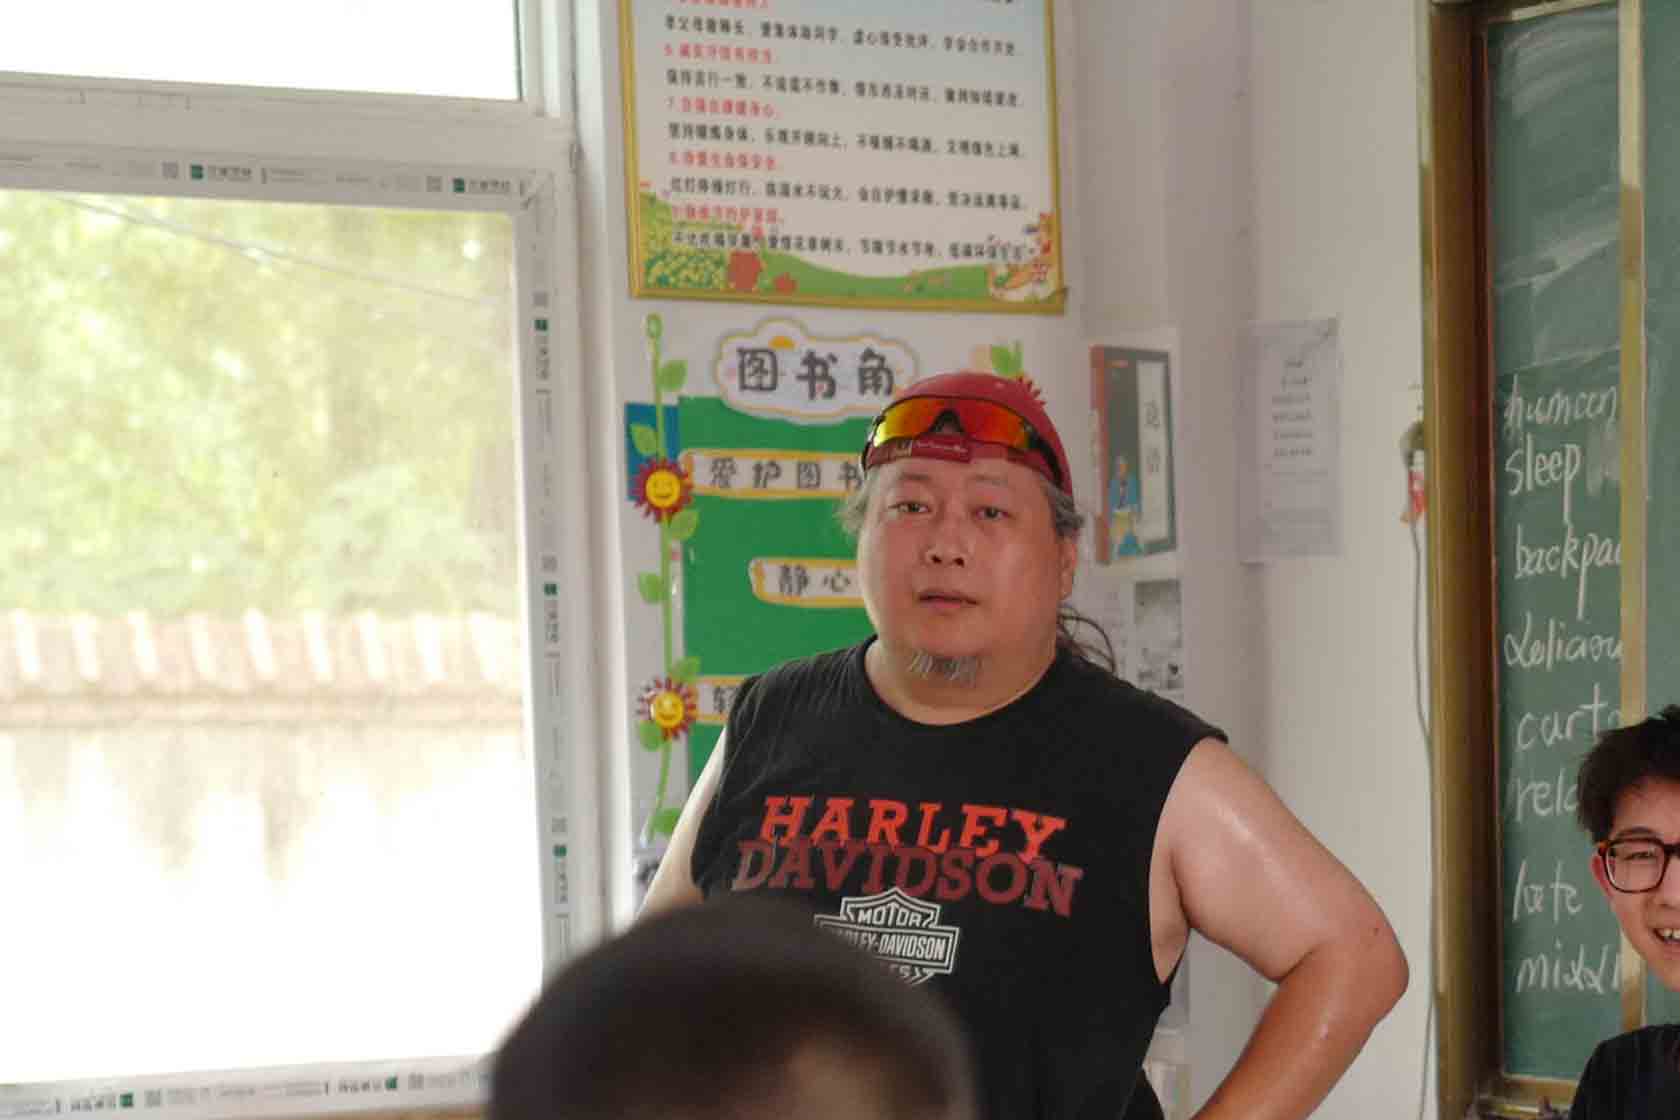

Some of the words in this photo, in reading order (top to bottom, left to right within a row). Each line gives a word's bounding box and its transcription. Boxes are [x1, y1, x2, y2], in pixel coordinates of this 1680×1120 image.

[737, 346, 894, 399] 图书角
[711, 457, 863, 491] 爱护图书
[1505, 432, 1582, 524] sleep
[759, 795, 1067, 864] HARLEY
[731, 838, 1084, 917] DAVIDSON
[856, 902, 923, 927] MOTOR
